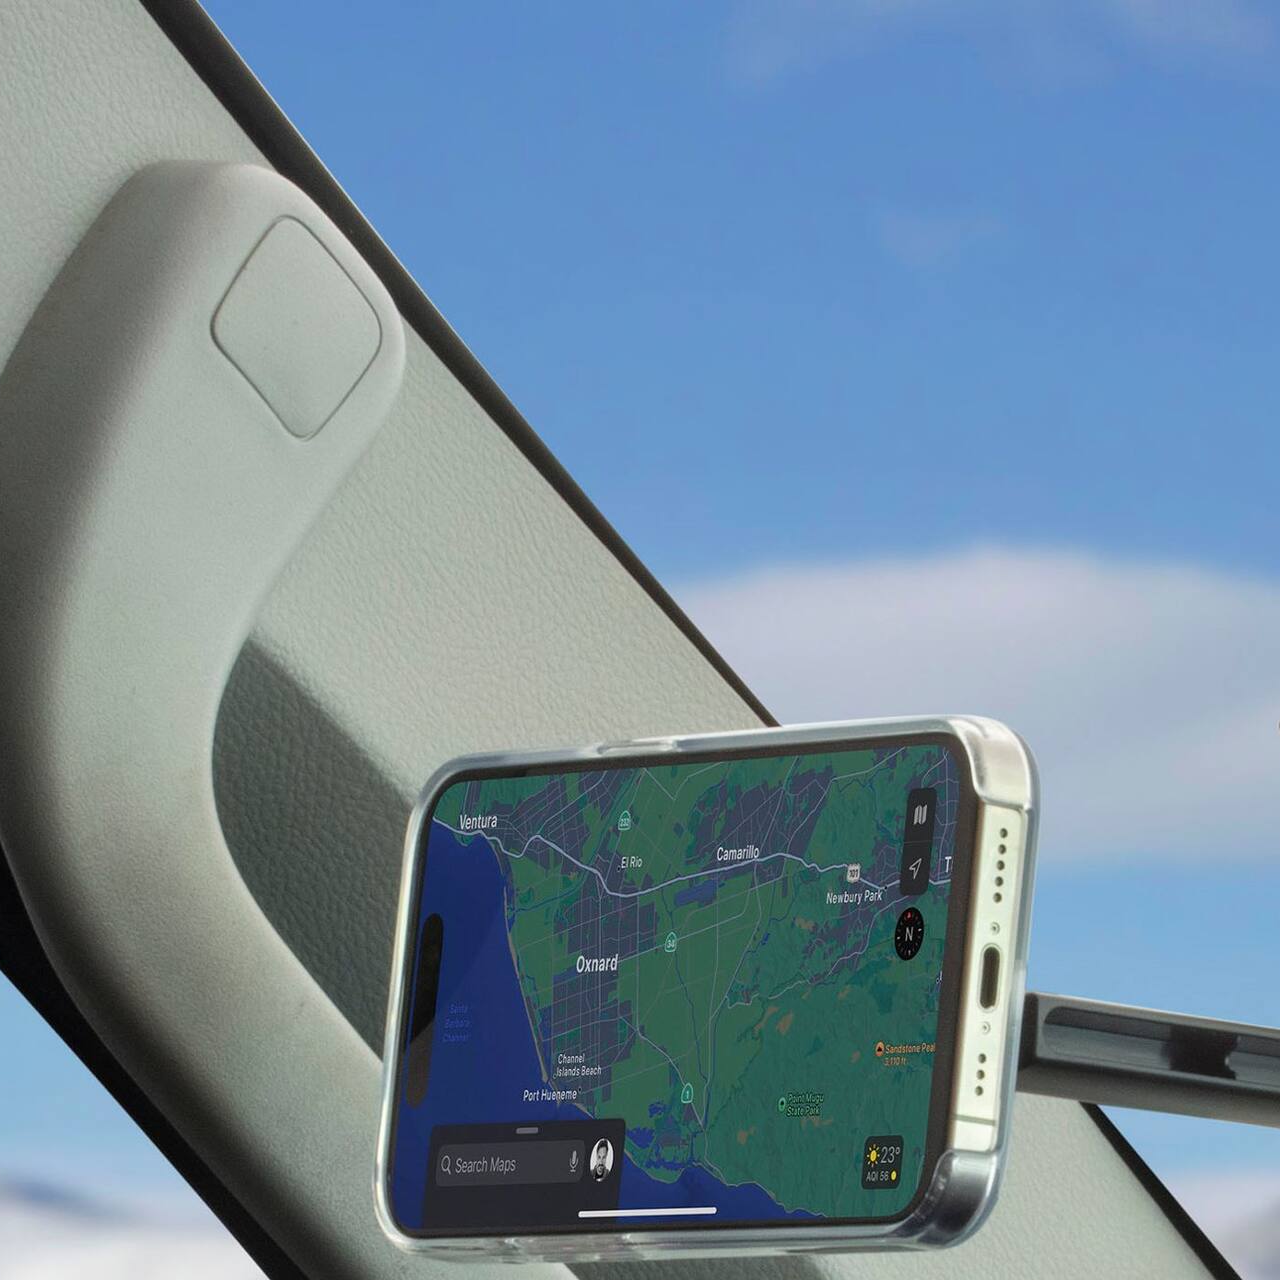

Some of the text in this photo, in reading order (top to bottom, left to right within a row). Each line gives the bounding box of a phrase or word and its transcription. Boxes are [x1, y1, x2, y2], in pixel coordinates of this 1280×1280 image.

[459, 813, 498, 830] Ventura
[716, 845, 760, 861] Camarillo
[621, 856, 643, 868] El Rio
[826, 889, 883, 905] Newbury Park
[905, 926, 914, 942] N
[576, 953, 619, 973] Oxnard
[885, 1044, 921, 1054] Sandstone
[557, 1053, 585, 1064] Channel
[556, 1065, 602, 1077] Islands Beach
[523, 1089, 577, 1102] Port Hueneme
[787, 1104, 820, 1117] State Park
[455, 1156, 516, 1176] Search Maps
[865, 1171, 879, 1182] AQI
